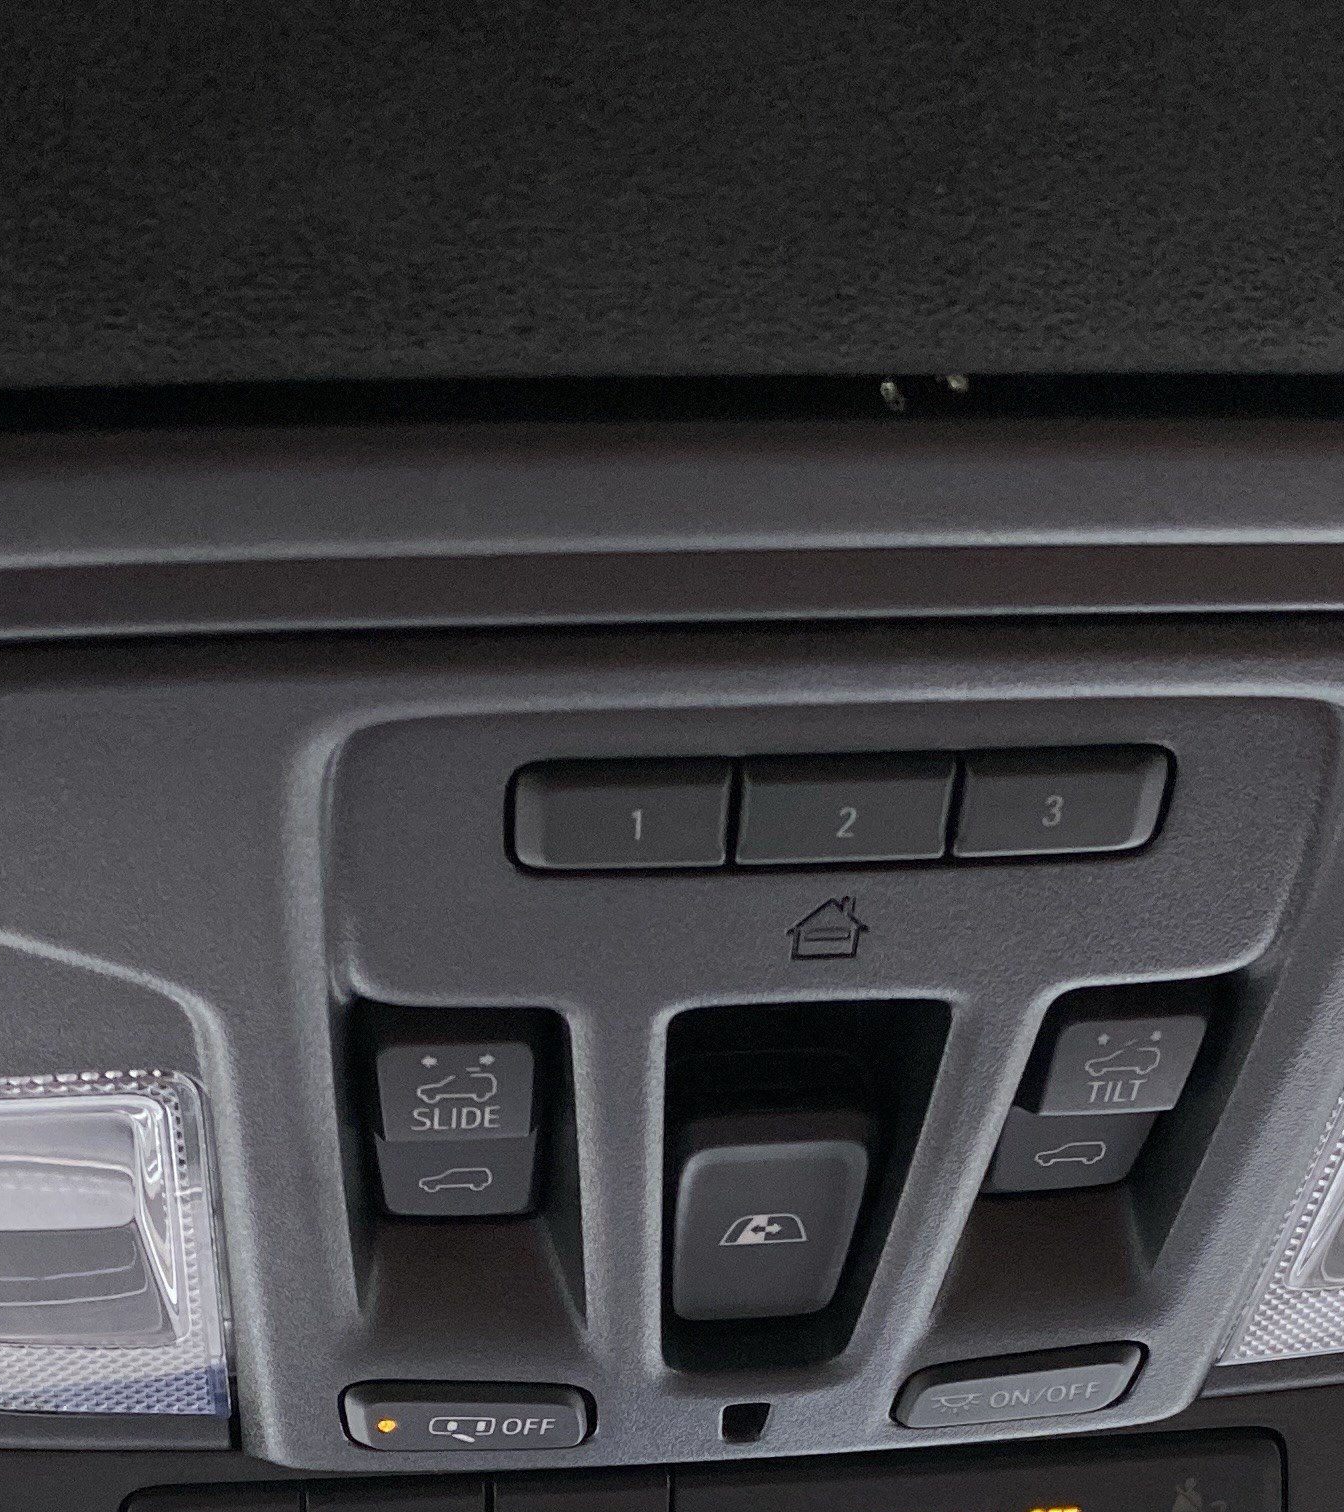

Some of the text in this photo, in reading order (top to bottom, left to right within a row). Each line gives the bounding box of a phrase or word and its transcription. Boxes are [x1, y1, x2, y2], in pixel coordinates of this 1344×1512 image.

[630, 808, 644, 840] 1
[835, 806, 857, 839] 2
[1041, 794, 1064, 828] 3
[1087, 1079, 1149, 1106] TILT
[409, 1104, 502, 1132] SLIDE
[989, 1380, 1102, 1410] ON/OFF
[501, 1417, 557, 1436] OFF
